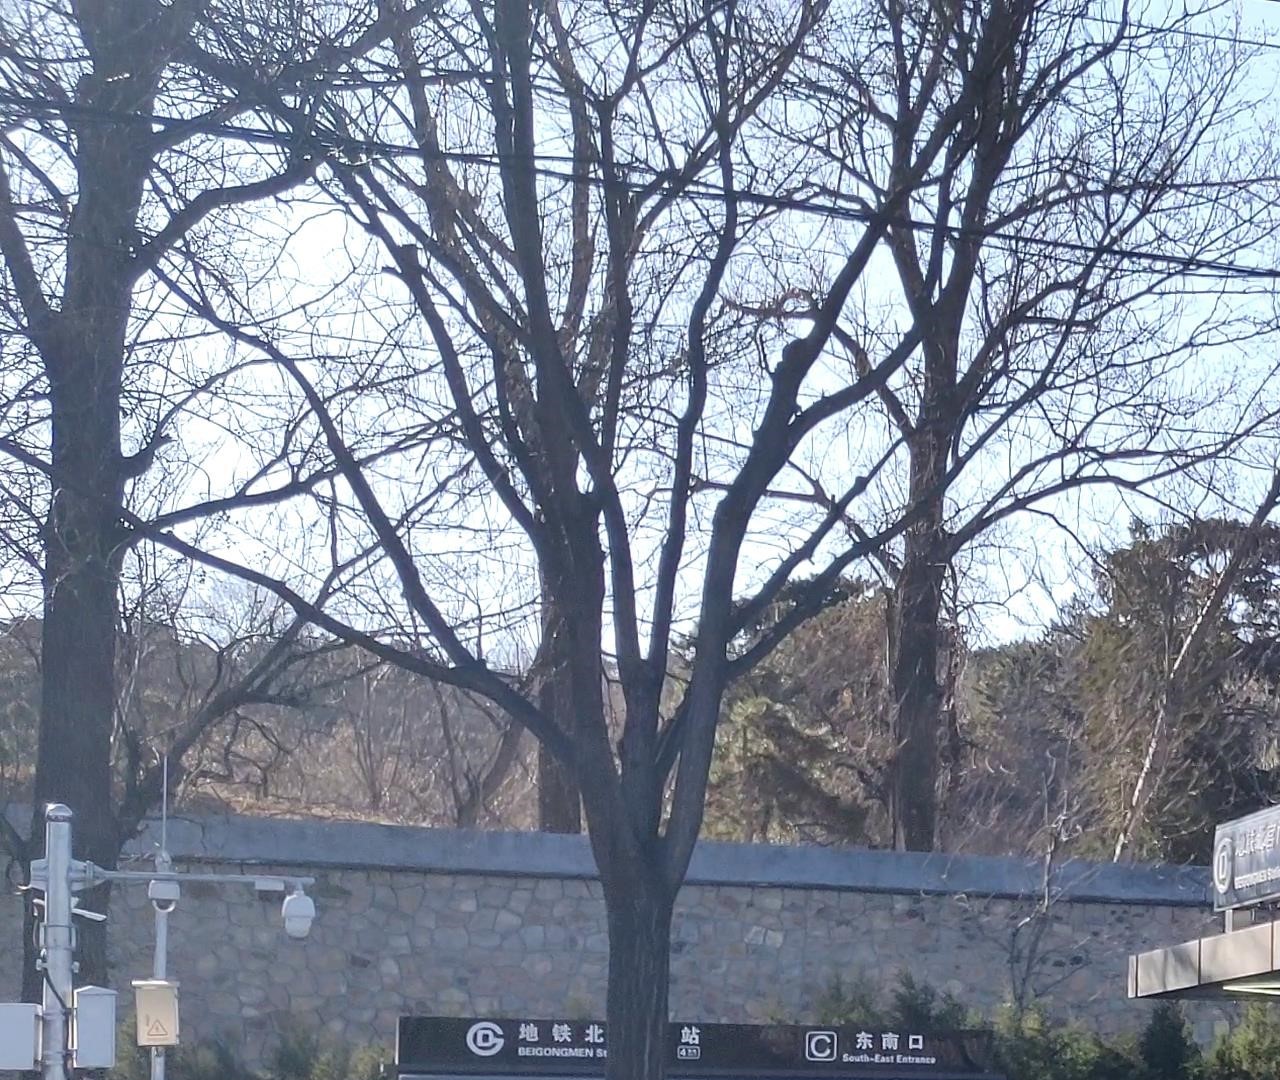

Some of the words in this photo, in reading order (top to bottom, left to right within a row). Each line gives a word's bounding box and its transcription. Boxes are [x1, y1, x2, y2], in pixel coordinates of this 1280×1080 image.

[810, 1034, 831, 1057] C
[856, 1031, 923, 1050] 东南口
[518, 1047, 594, 1058] BEIGONGMEN
[842, 1053, 894, 1063] South-East
[896, 1054, 936, 1064] Entrance
